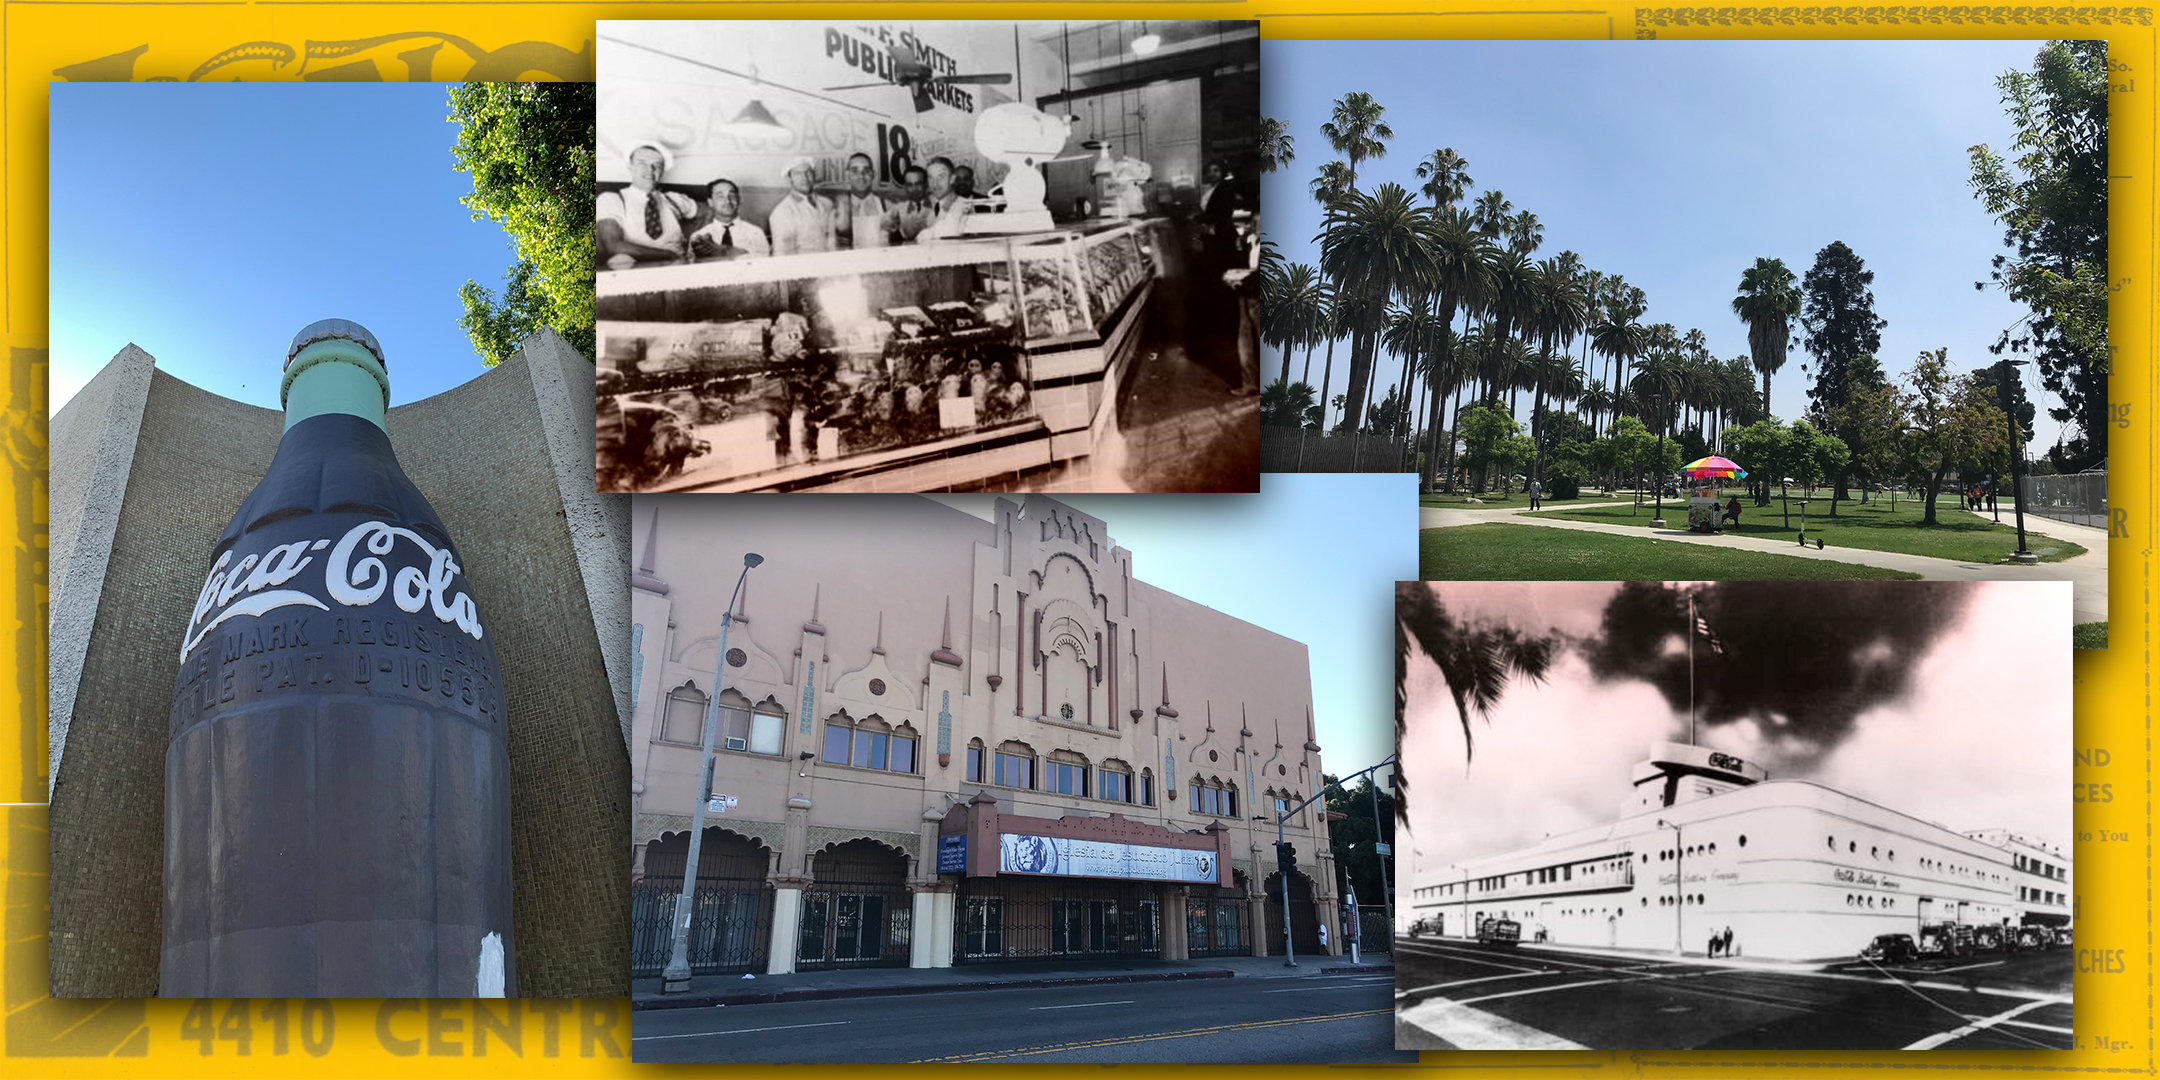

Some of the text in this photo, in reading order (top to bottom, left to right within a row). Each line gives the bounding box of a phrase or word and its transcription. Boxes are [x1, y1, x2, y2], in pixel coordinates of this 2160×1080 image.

[825, 27, 973, 114] PUBLI ARKETS
[900, 30, 957, 77] SMITH
[180, 520, 484, 666] Coca-Cola
[222, 616, 309, 666] MARK
[331, 614, 496, 690] REGISTERE
[255, 651, 334, 693] PAT.
[2077, 829, 2129, 842] to You
[180, 999, 632, 1059] 4410 CENTR
[2094, 1035, 2134, 1053] Mgr.
